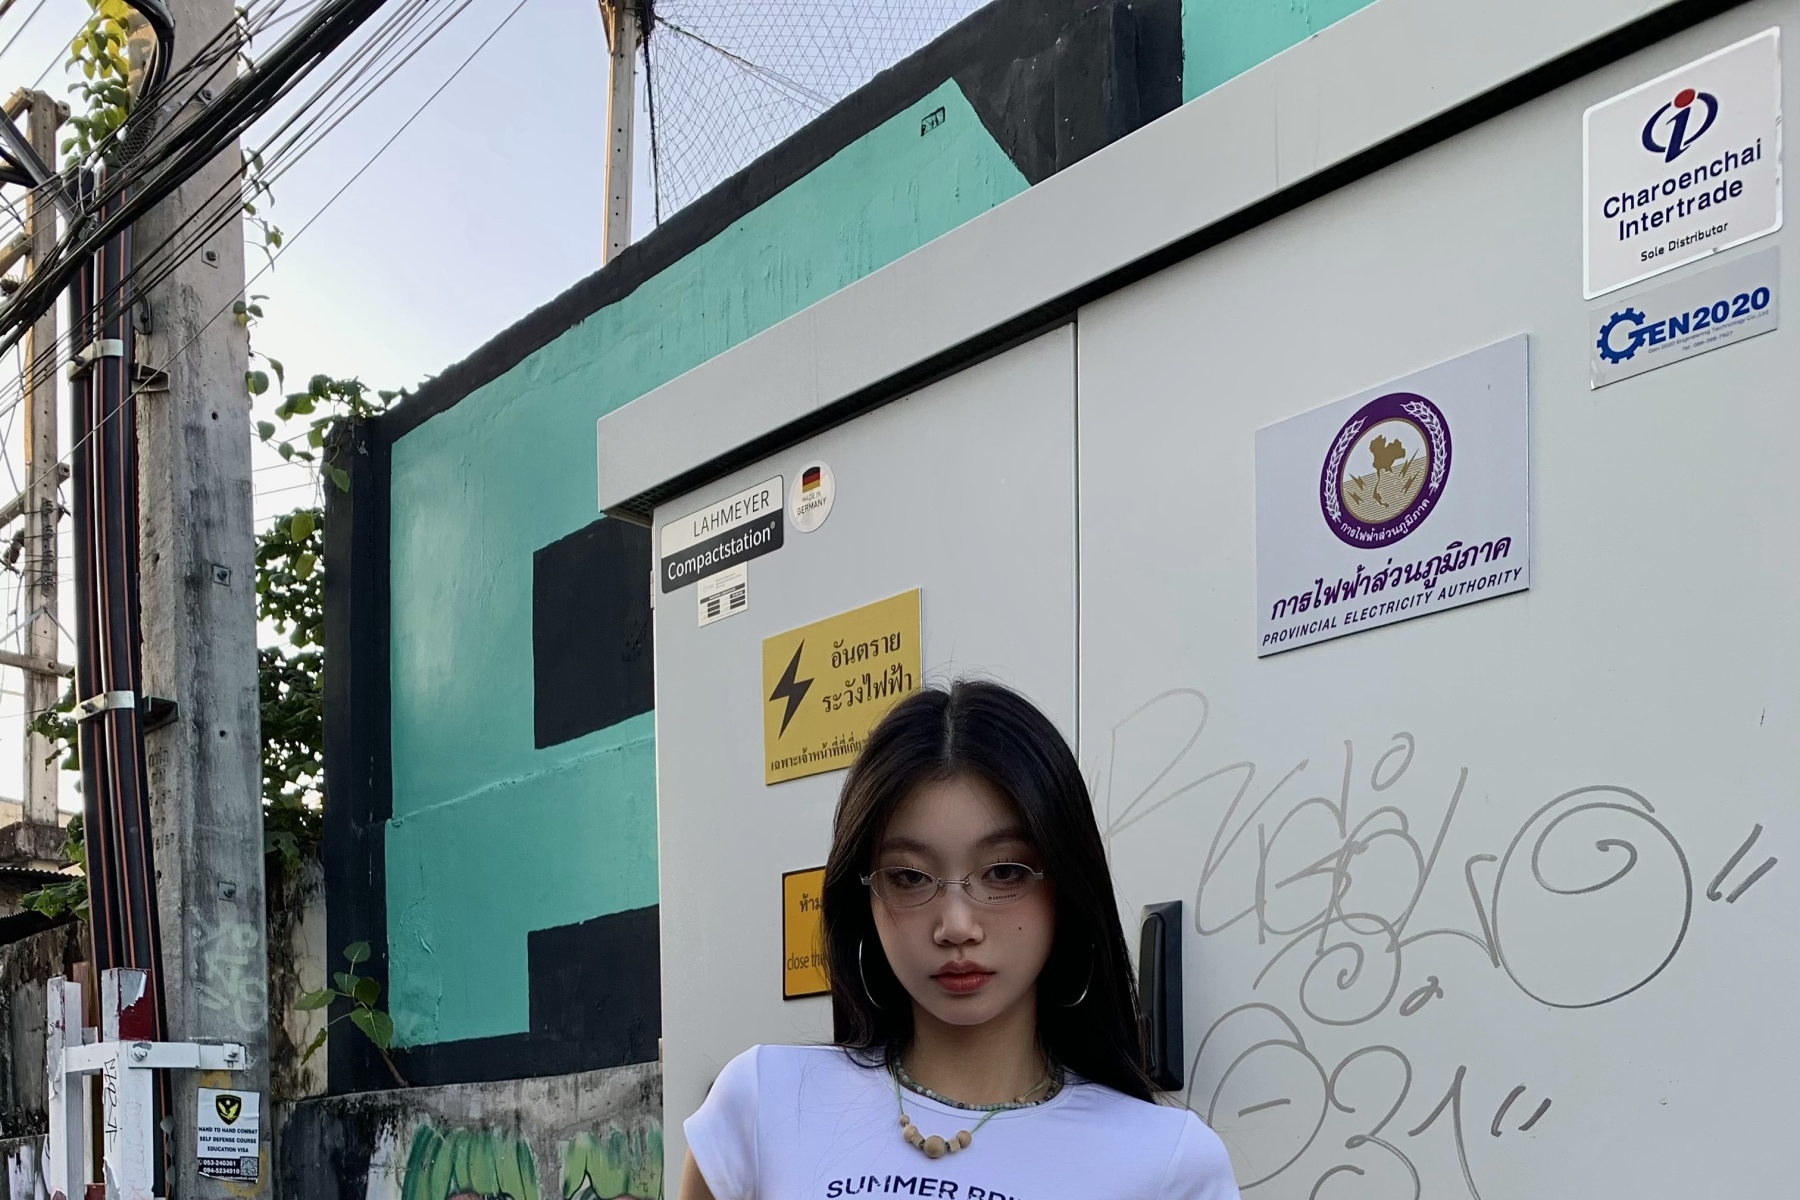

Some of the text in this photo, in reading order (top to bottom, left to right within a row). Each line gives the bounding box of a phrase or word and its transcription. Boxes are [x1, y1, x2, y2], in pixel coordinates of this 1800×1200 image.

[1603, 138, 1762, 219] Charoenchai
[1619, 180, 1743, 241] Intertrade
[1640, 222, 1728, 262] Sole Distributor
[693, 490, 769, 538] LAHMEYER
[797, 496, 826, 516] GERMANY
[802, 492, 815, 503] MADE
[1340, 498, 1430, 542] การไฟฟ้าส่วนภูมิภาค
[1271, 536, 1511, 621] การไฟฟ้าส่วนภูมิภาค
[1262, 567, 1523, 647] PROVINCIAL ELECTRICITY AUTHORITY
[831, 631, 901, 669] อันตราย
[822, 662, 912, 713] ระวังไฟฟ้า
[787, 952, 809, 971] close
[827, 1174, 959, 1200] SUMMER
